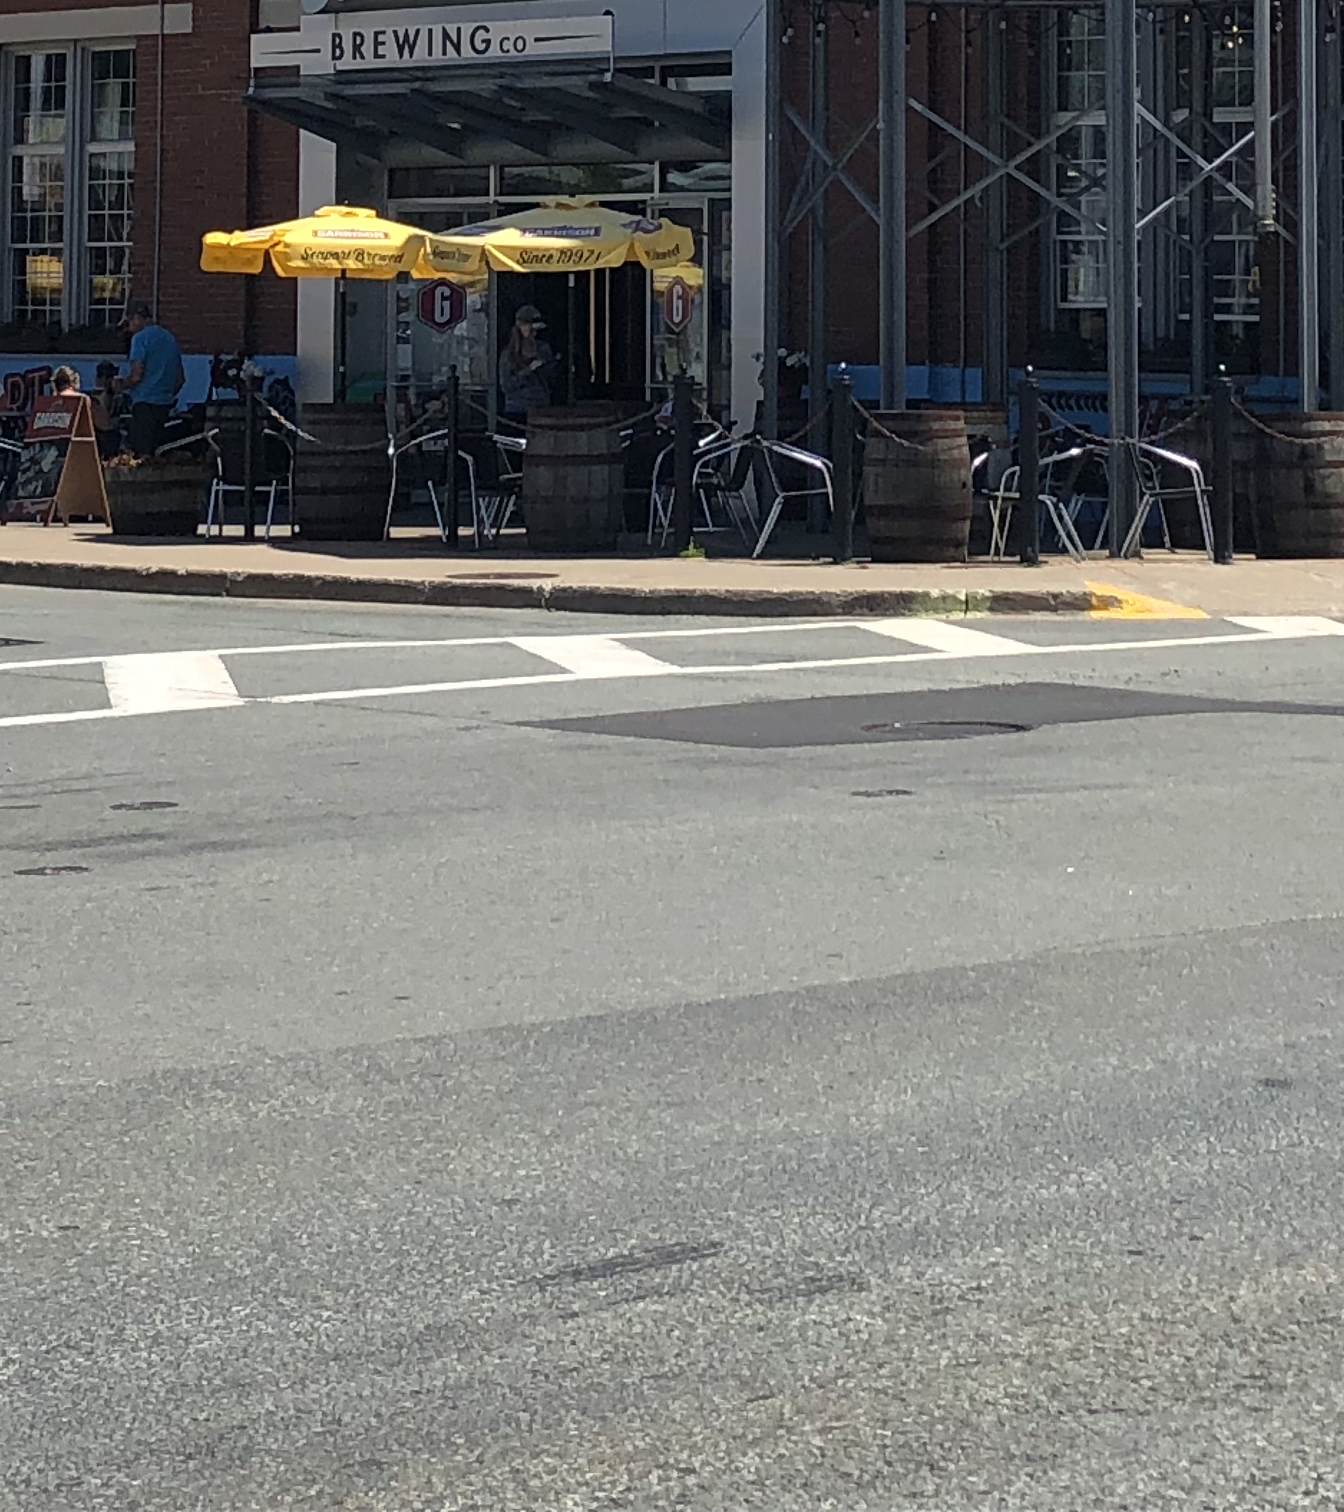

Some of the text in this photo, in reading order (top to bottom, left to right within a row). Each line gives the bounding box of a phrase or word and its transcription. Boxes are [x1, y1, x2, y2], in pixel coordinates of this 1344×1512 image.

[331, 24, 492, 61] BREWING
[517, 249, 554, 265] Since
[434, 286, 452, 324] G
[673, 285, 683, 324] G
